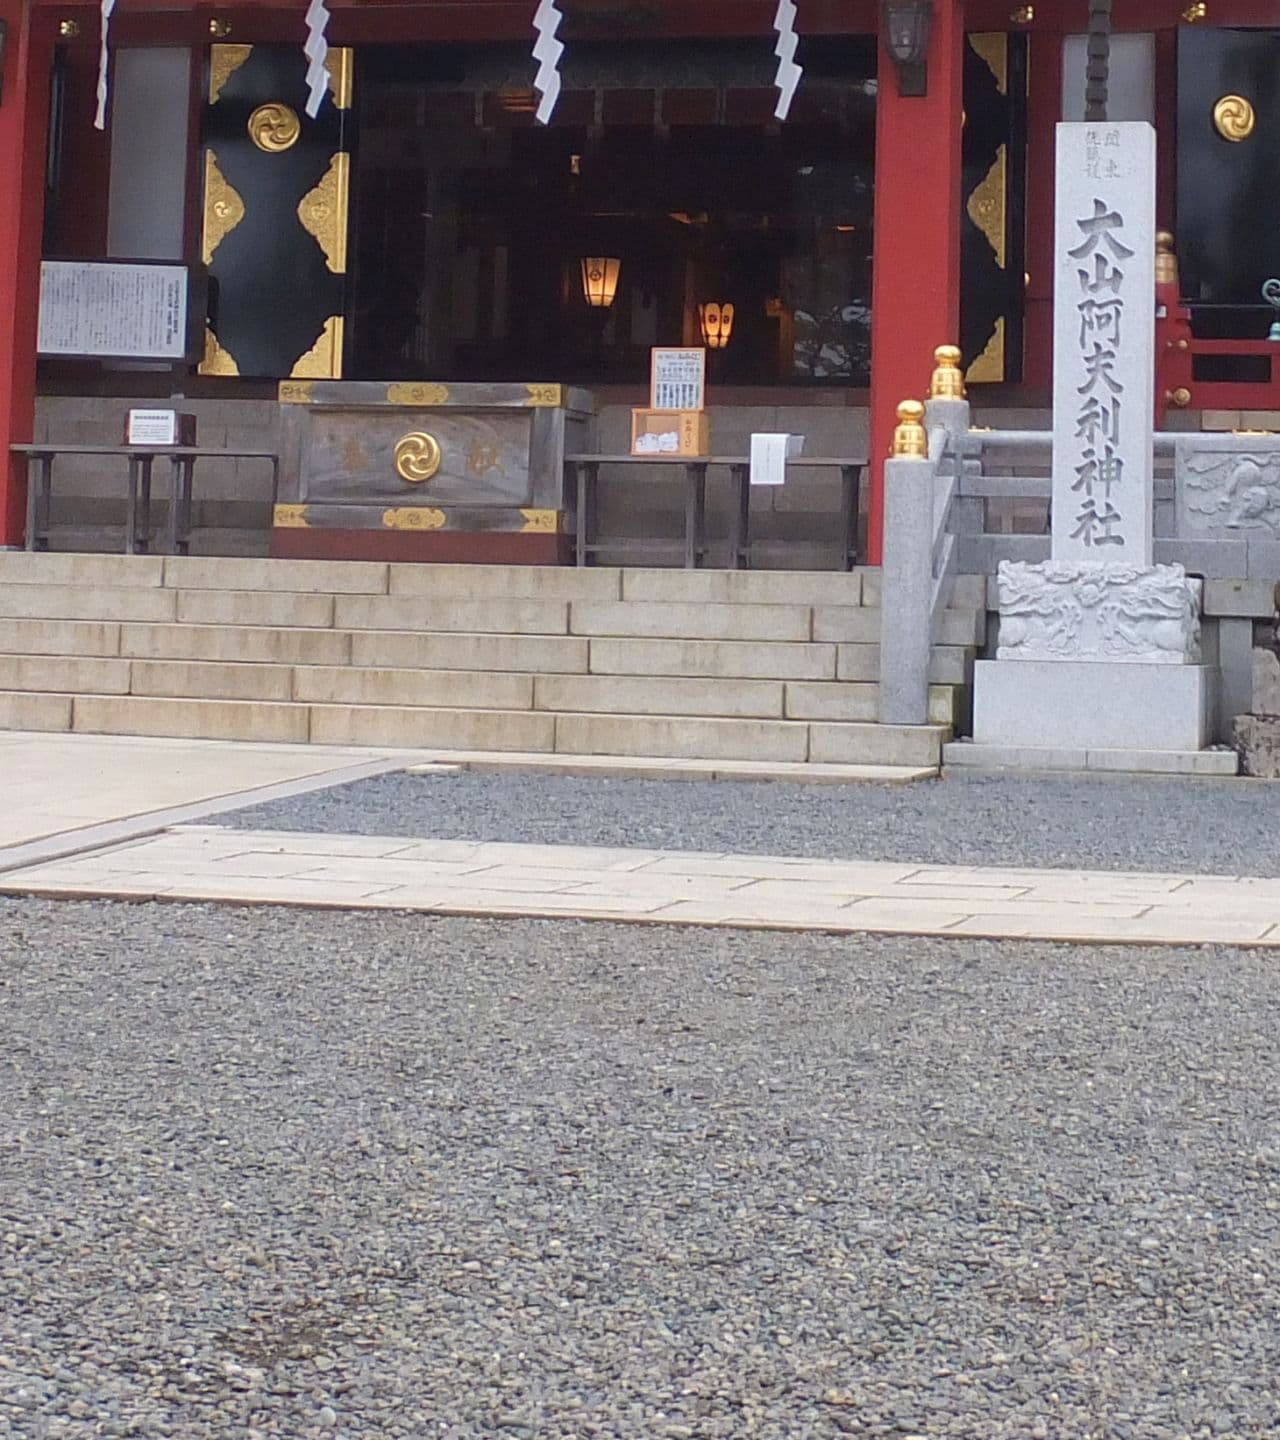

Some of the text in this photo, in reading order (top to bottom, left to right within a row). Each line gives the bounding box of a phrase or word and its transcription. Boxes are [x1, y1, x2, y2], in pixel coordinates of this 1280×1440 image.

[1068, 197, 1135, 547] 大山阿夫利神社
